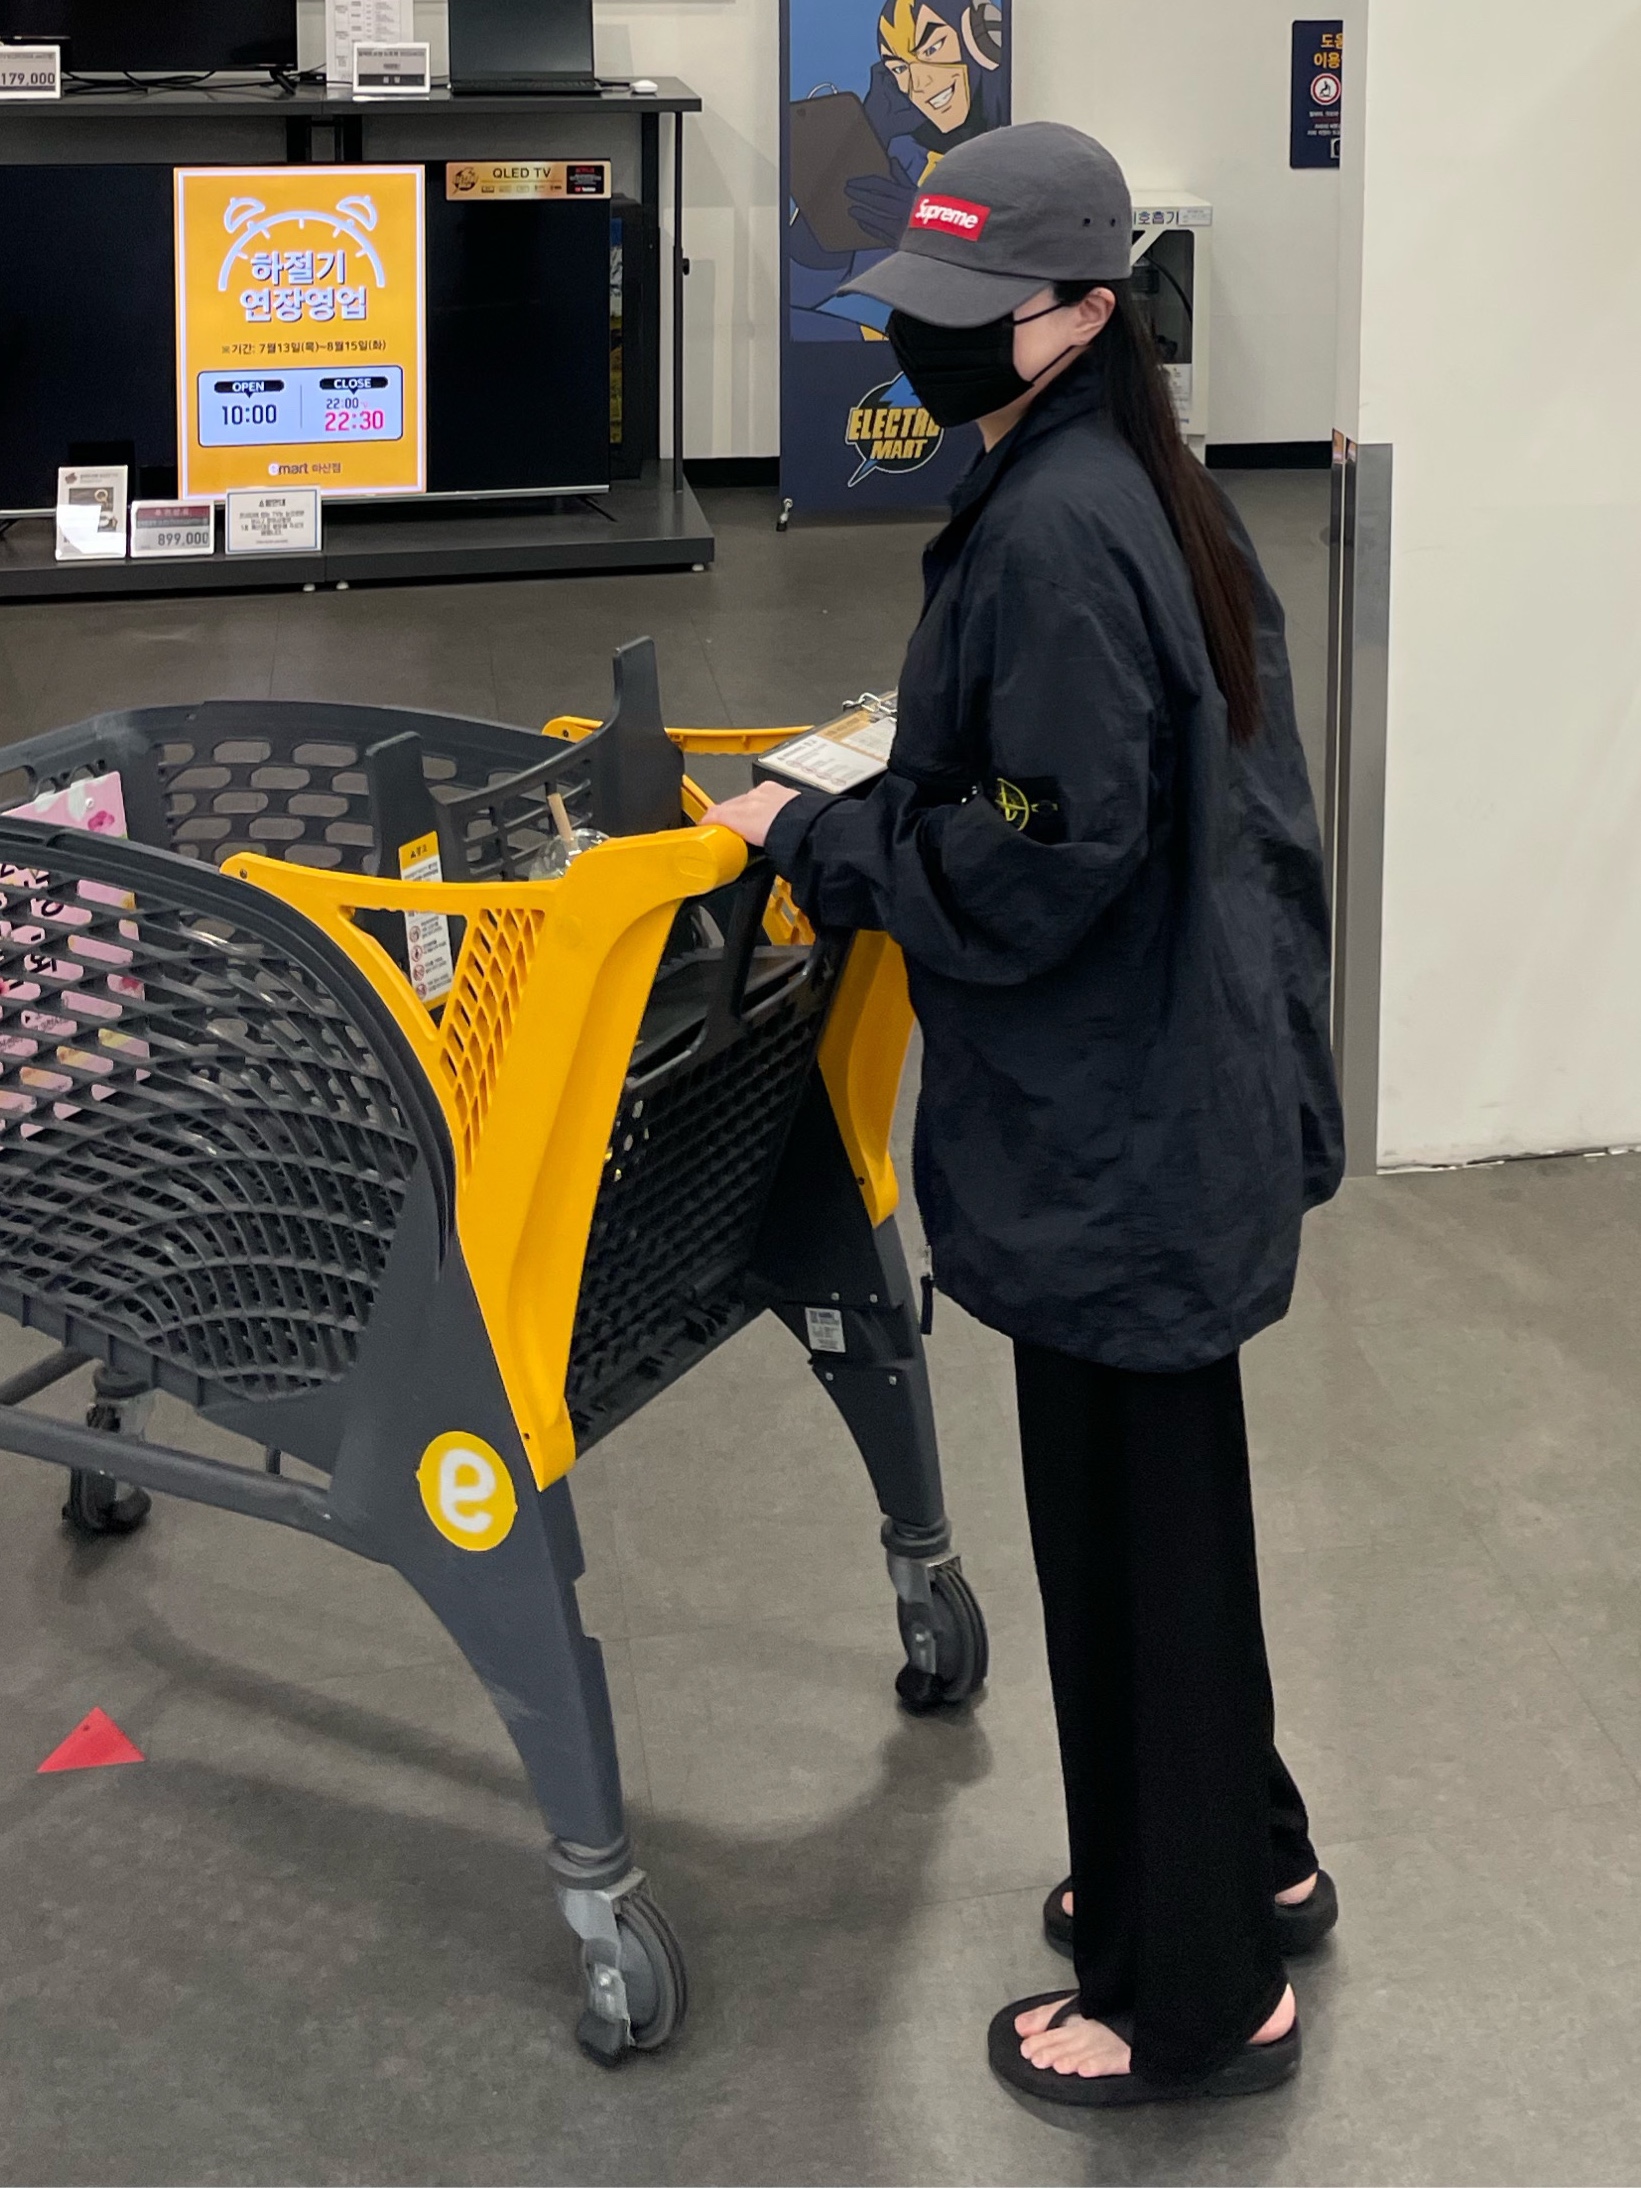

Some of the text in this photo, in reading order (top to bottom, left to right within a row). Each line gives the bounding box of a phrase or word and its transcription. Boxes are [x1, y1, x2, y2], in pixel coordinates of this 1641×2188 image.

[1313, 52, 1343, 68] 이용
[0, 72, 56, 87] 179,000
[492, 167, 552, 179] QLED TV
[915, 198, 979, 229] Supreme
[1132, 210, 1179, 225] 호흡기
[250, 250, 346, 285] 하절기
[240, 286, 367, 323] 연장영업
[232, 381, 265, 393] OPEN
[333, 378, 372, 390] CLOSE
[326, 397, 359, 410] 22:00
[221, 404, 278, 426] 10:00
[324, 410, 385, 432] 22:30
[869, 439, 928, 460] MART
[157, 531, 210, 547] 899,000
[439, 1448, 497, 1534] e
